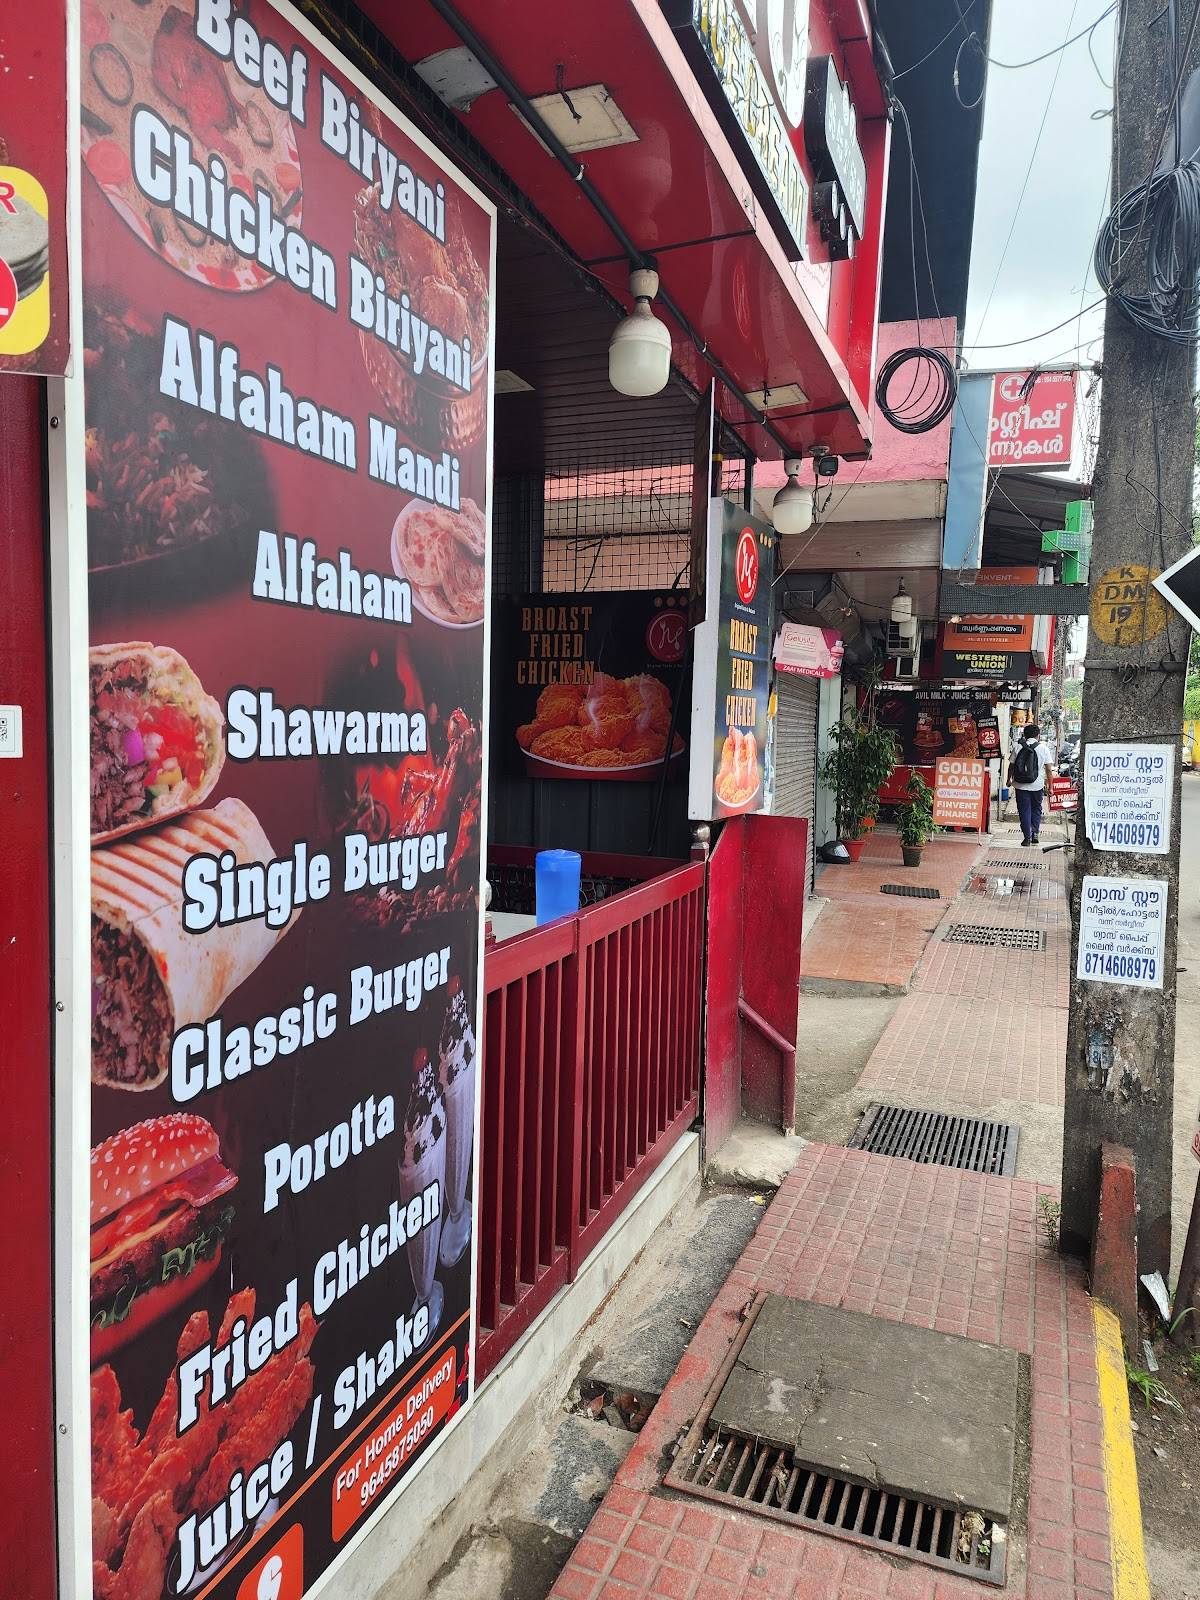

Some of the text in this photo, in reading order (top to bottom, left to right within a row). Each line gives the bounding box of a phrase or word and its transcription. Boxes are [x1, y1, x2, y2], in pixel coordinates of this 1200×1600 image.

[196, 0, 446, 242] Beef Biryani
[132, 105, 473, 392] Chicken Biriyani
[158, 316, 461, 512] Alfaham Mandi
[991, 402, 1068, 438] ംഗ്ലീഷ്
[991, 435, 1064, 460] ന്നുകൾ
[252, 529, 413, 624] Alfaham
[1119, 567, 1135, 579] K
[1104, 584, 1144, 601] DM
[521, 606, 593, 632] BROAST
[1109, 605, 1132, 624] 19
[529, 633, 583, 658] FRIED
[730, 618, 758, 656] BROAST
[955, 654, 1006, 662] WESTERN
[517, 660, 595, 686] CHICKEN
[731, 657, 754, 691] FRIED
[915, 692, 930, 700] AVIL
[931, 692, 946, 700] MILK
[950, 692, 970, 700] JUICE
[975, 692, 994, 700] SHAK
[226, 689, 427, 759] Shawarma
[725, 694, 757, 728] CHICKEN
[938, 761, 983, 775] GOLD
[1091, 753, 1132, 771] ഗ്യാസ്
[937, 775, 983, 788] LOAN
[936, 800, 978, 809] FINVENT
[936, 809, 978, 819] FINANCE
[1090, 810, 1118, 820] ലൈൻ
[1097, 798, 1122, 808] ഗ്യാസ്
[1091, 821, 1160, 846] 8714608979
[183, 830, 448, 931] Single Burger
[1087, 886, 1128, 902] ഗ്യാസ്
[1085, 942, 1114, 952] ലൈൻ
[1093, 930, 1118, 940] ഗ്യാസ്
[1085, 952, 1156, 980] 8714608979
[170, 945, 452, 1103] Classic Burger
[263, 1094, 396, 1214] Porotta
[177, 1180, 441, 1434] Fried Chicken
[336, 1356, 454, 1501] For Home Delivery
[174, 1438, 295, 1595] Juice
[333, 1306, 430, 1430] Shake
[360, 1406, 435, 1507] 9645875050
